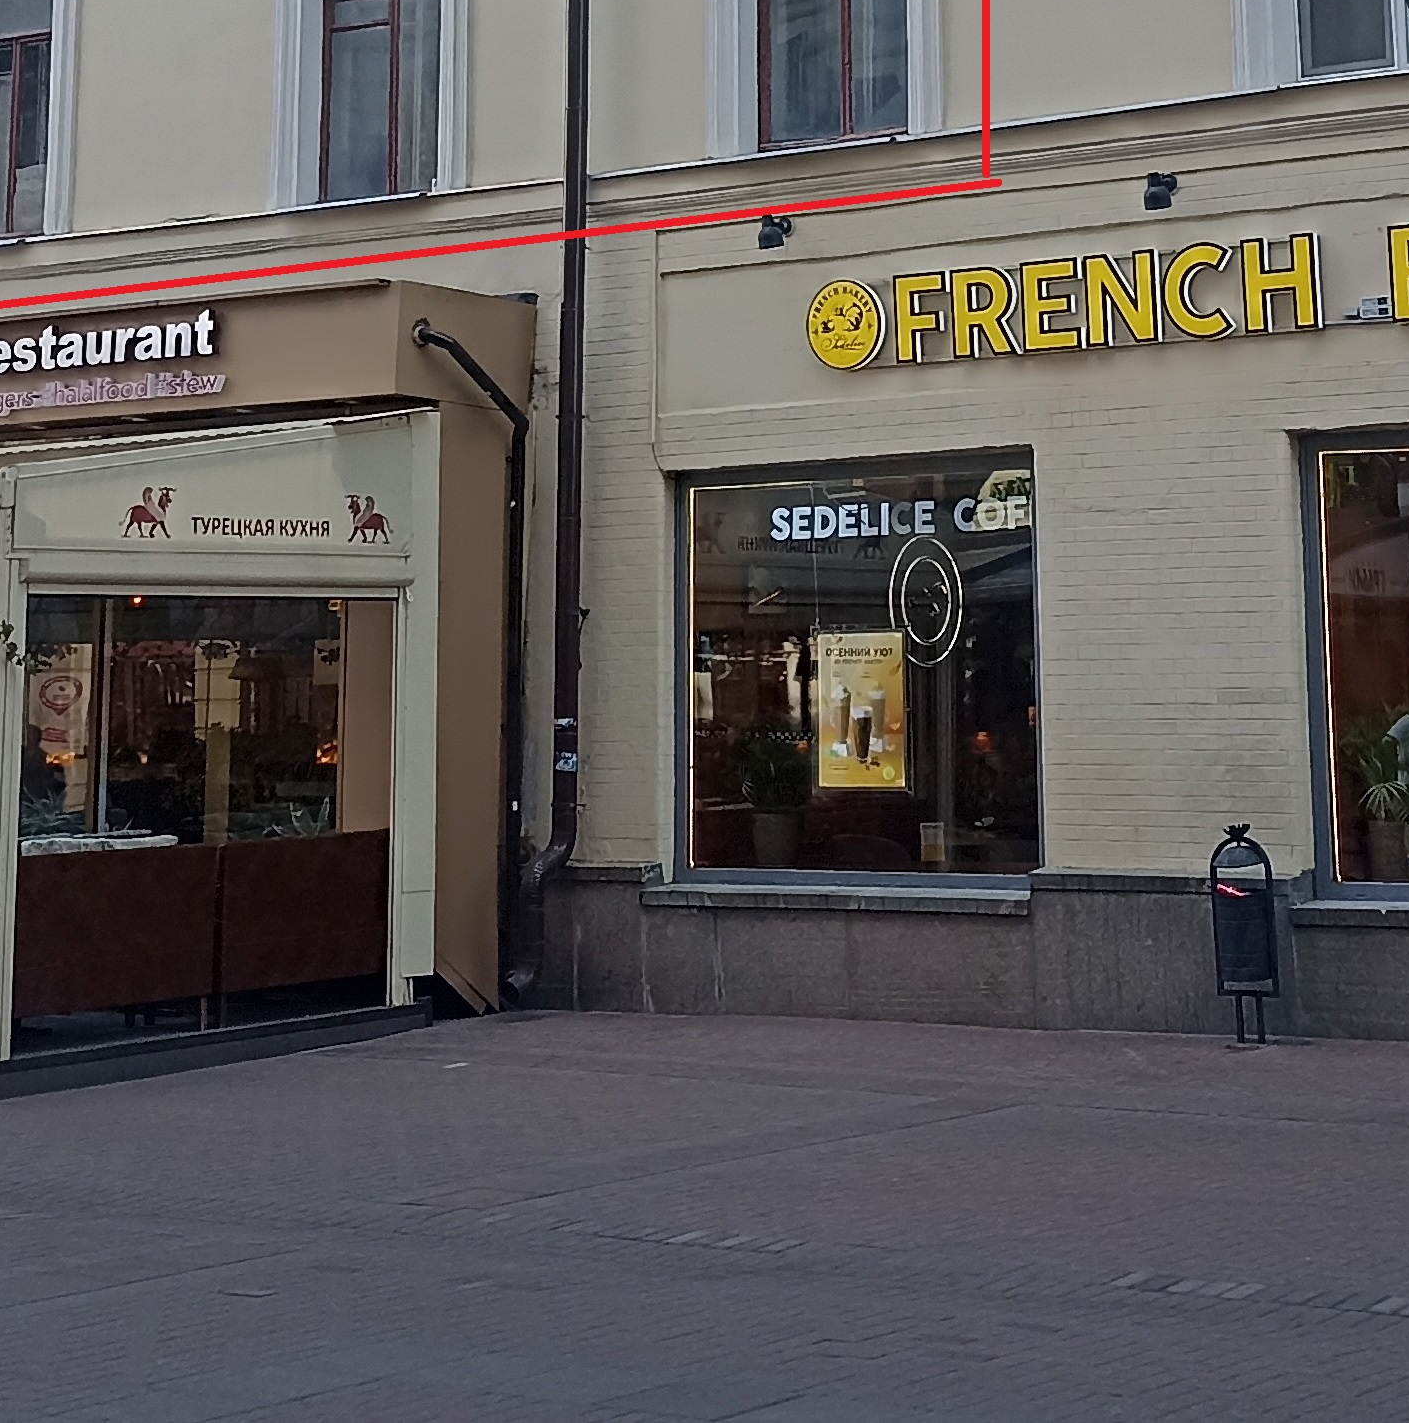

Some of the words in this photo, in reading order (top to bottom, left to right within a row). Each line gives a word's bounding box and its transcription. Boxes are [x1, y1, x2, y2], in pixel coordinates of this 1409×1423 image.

[812, 287, 839, 319] FRENCH
[893, 232, 1321, 364] FRENCH
[40, 373, 149, 406] #halalfood
[154, 370, 224, 393] #stew
[191, 516, 275, 538] ТУРЕЦКАЯ
[279, 519, 330, 538] КУХНЯ
[770, 500, 936, 541] SEDELICE
[825, 647, 871, 658] ОСЕННИЙ
[873, 647, 893, 658] УЮТ
